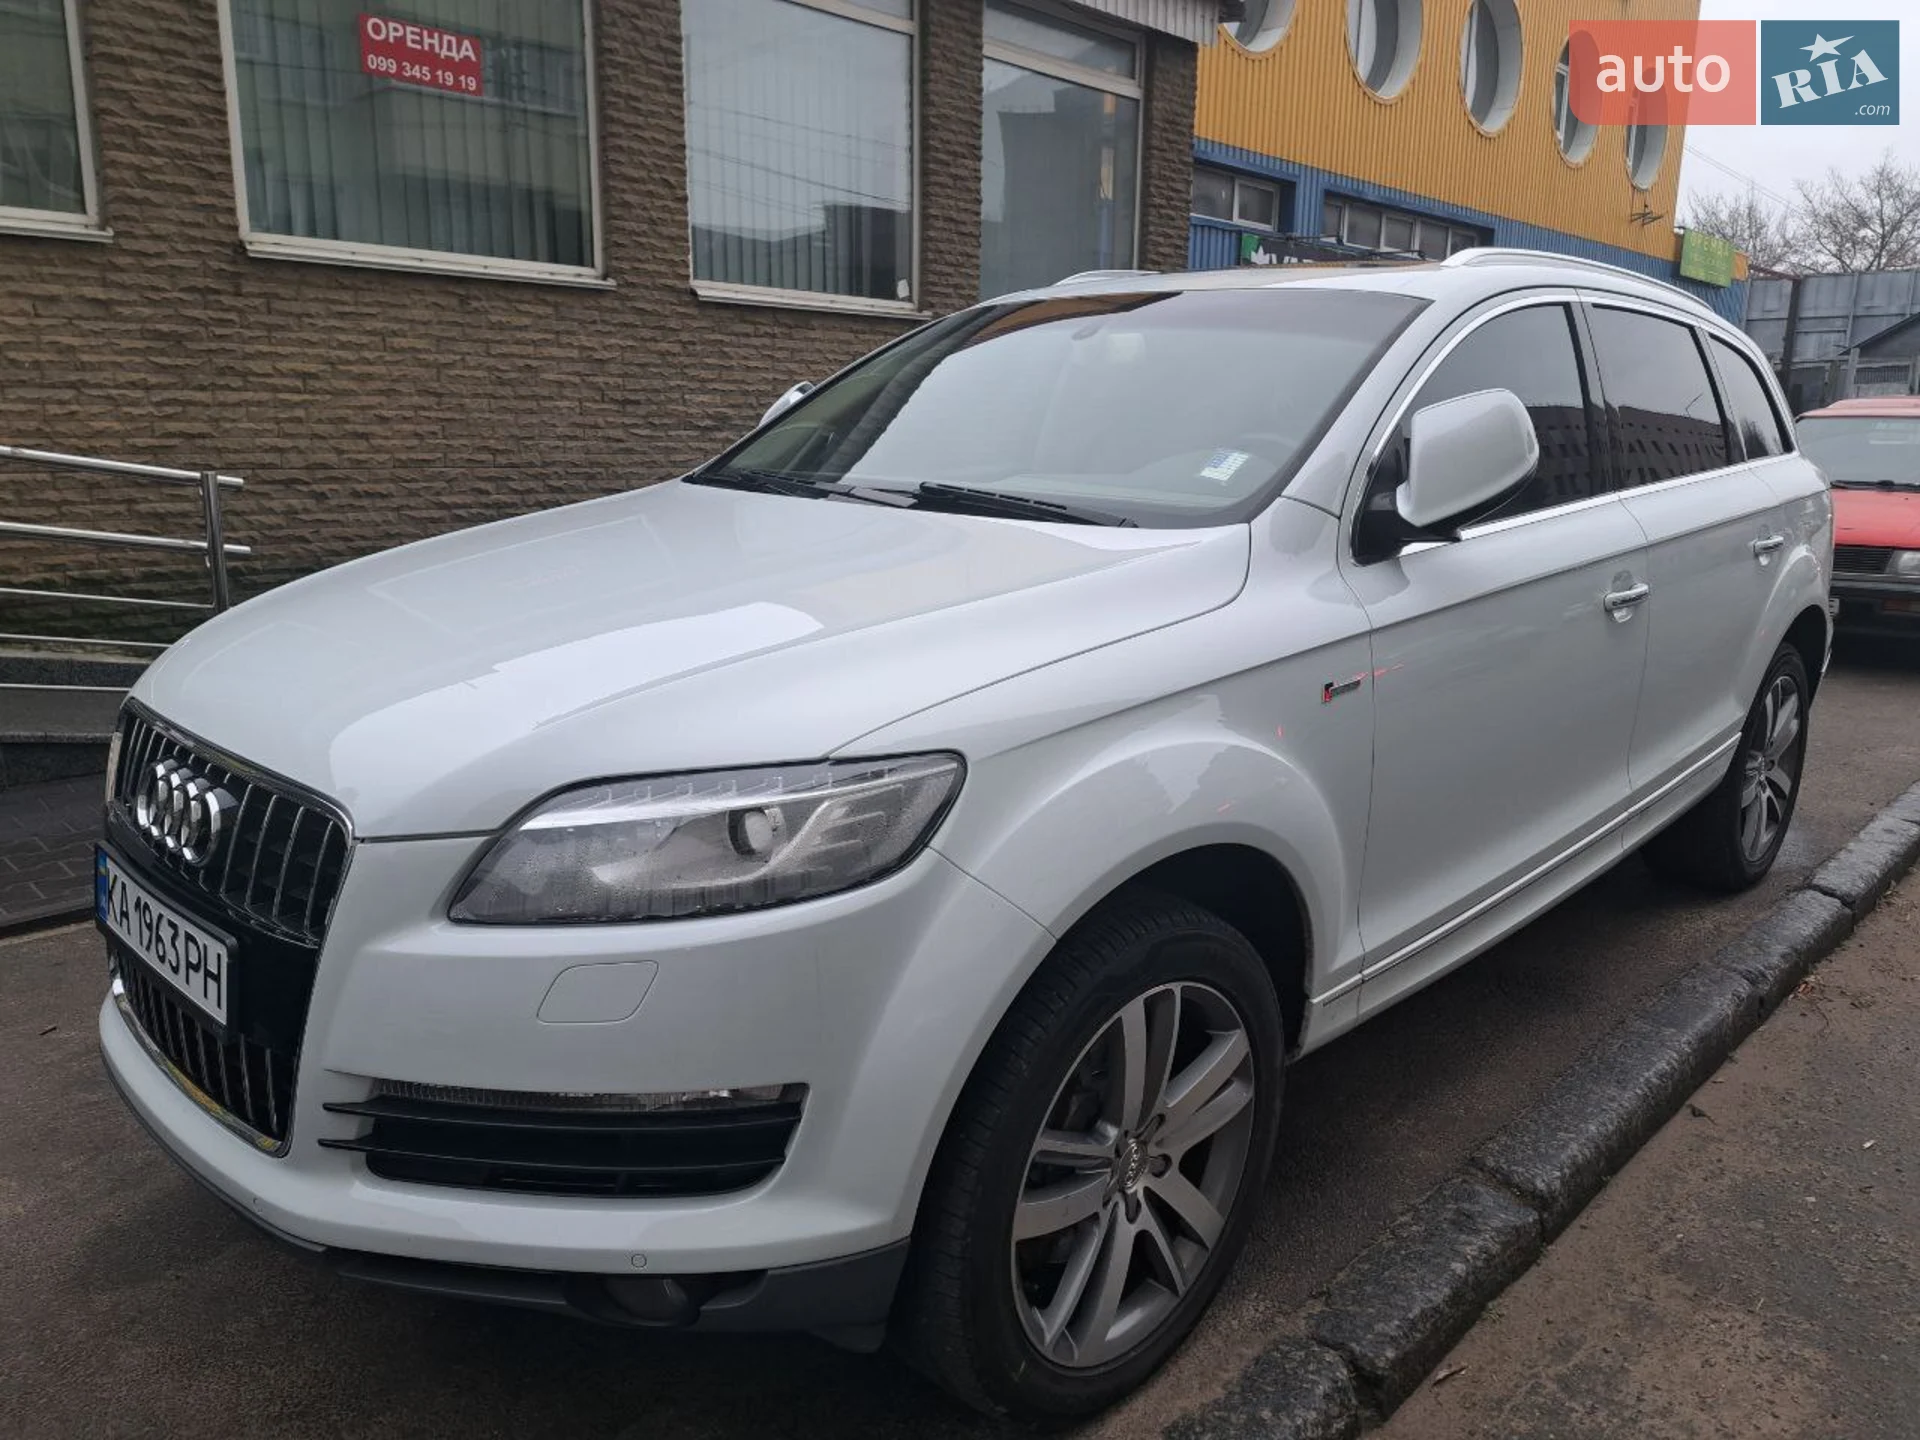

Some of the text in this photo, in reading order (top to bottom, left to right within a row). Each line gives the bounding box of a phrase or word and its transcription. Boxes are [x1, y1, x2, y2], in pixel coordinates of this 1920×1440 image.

[367, 17, 477, 62] ОРЕНДА
[367, 54, 477, 91] 099 345 19 19
